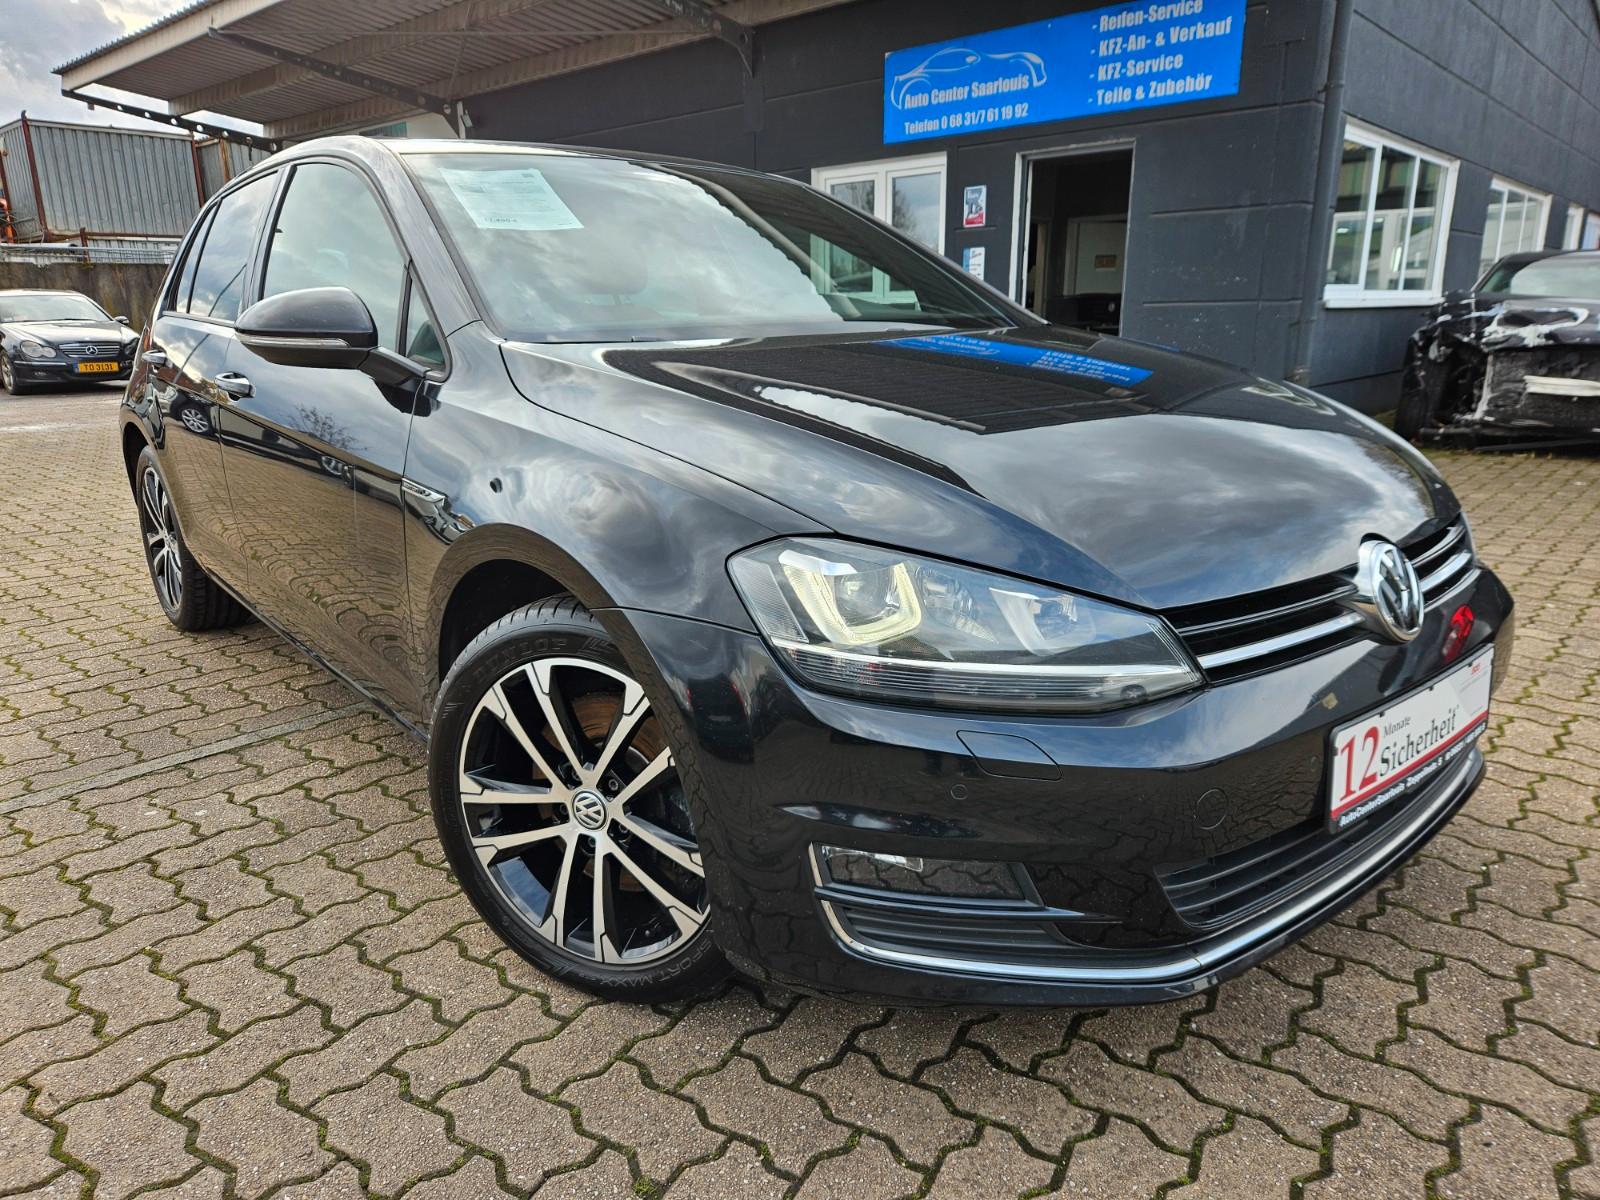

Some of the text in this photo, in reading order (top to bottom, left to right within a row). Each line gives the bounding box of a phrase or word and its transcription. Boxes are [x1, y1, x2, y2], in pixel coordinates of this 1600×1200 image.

[1100, 0, 1203, 32] Reifen-Service
[1099, 16, 1232, 57] KFZ-An- & Verkauf
[1097, 54, 1184, 82] KFZ-Service
[904, 74, 1030, 110] Auto Center Saarlouis
[1096, 72, 1213, 106] Teile & Zubehör
[904, 118, 939, 135] Telefon
[949, 113, 962, 128] 68
[1000, 105, 1013, 120] 19
[1014, 102, 1029, 118] 92
[1340, 726, 1379, 801] 12
[1380, 707, 1456, 777] Sicherheit
